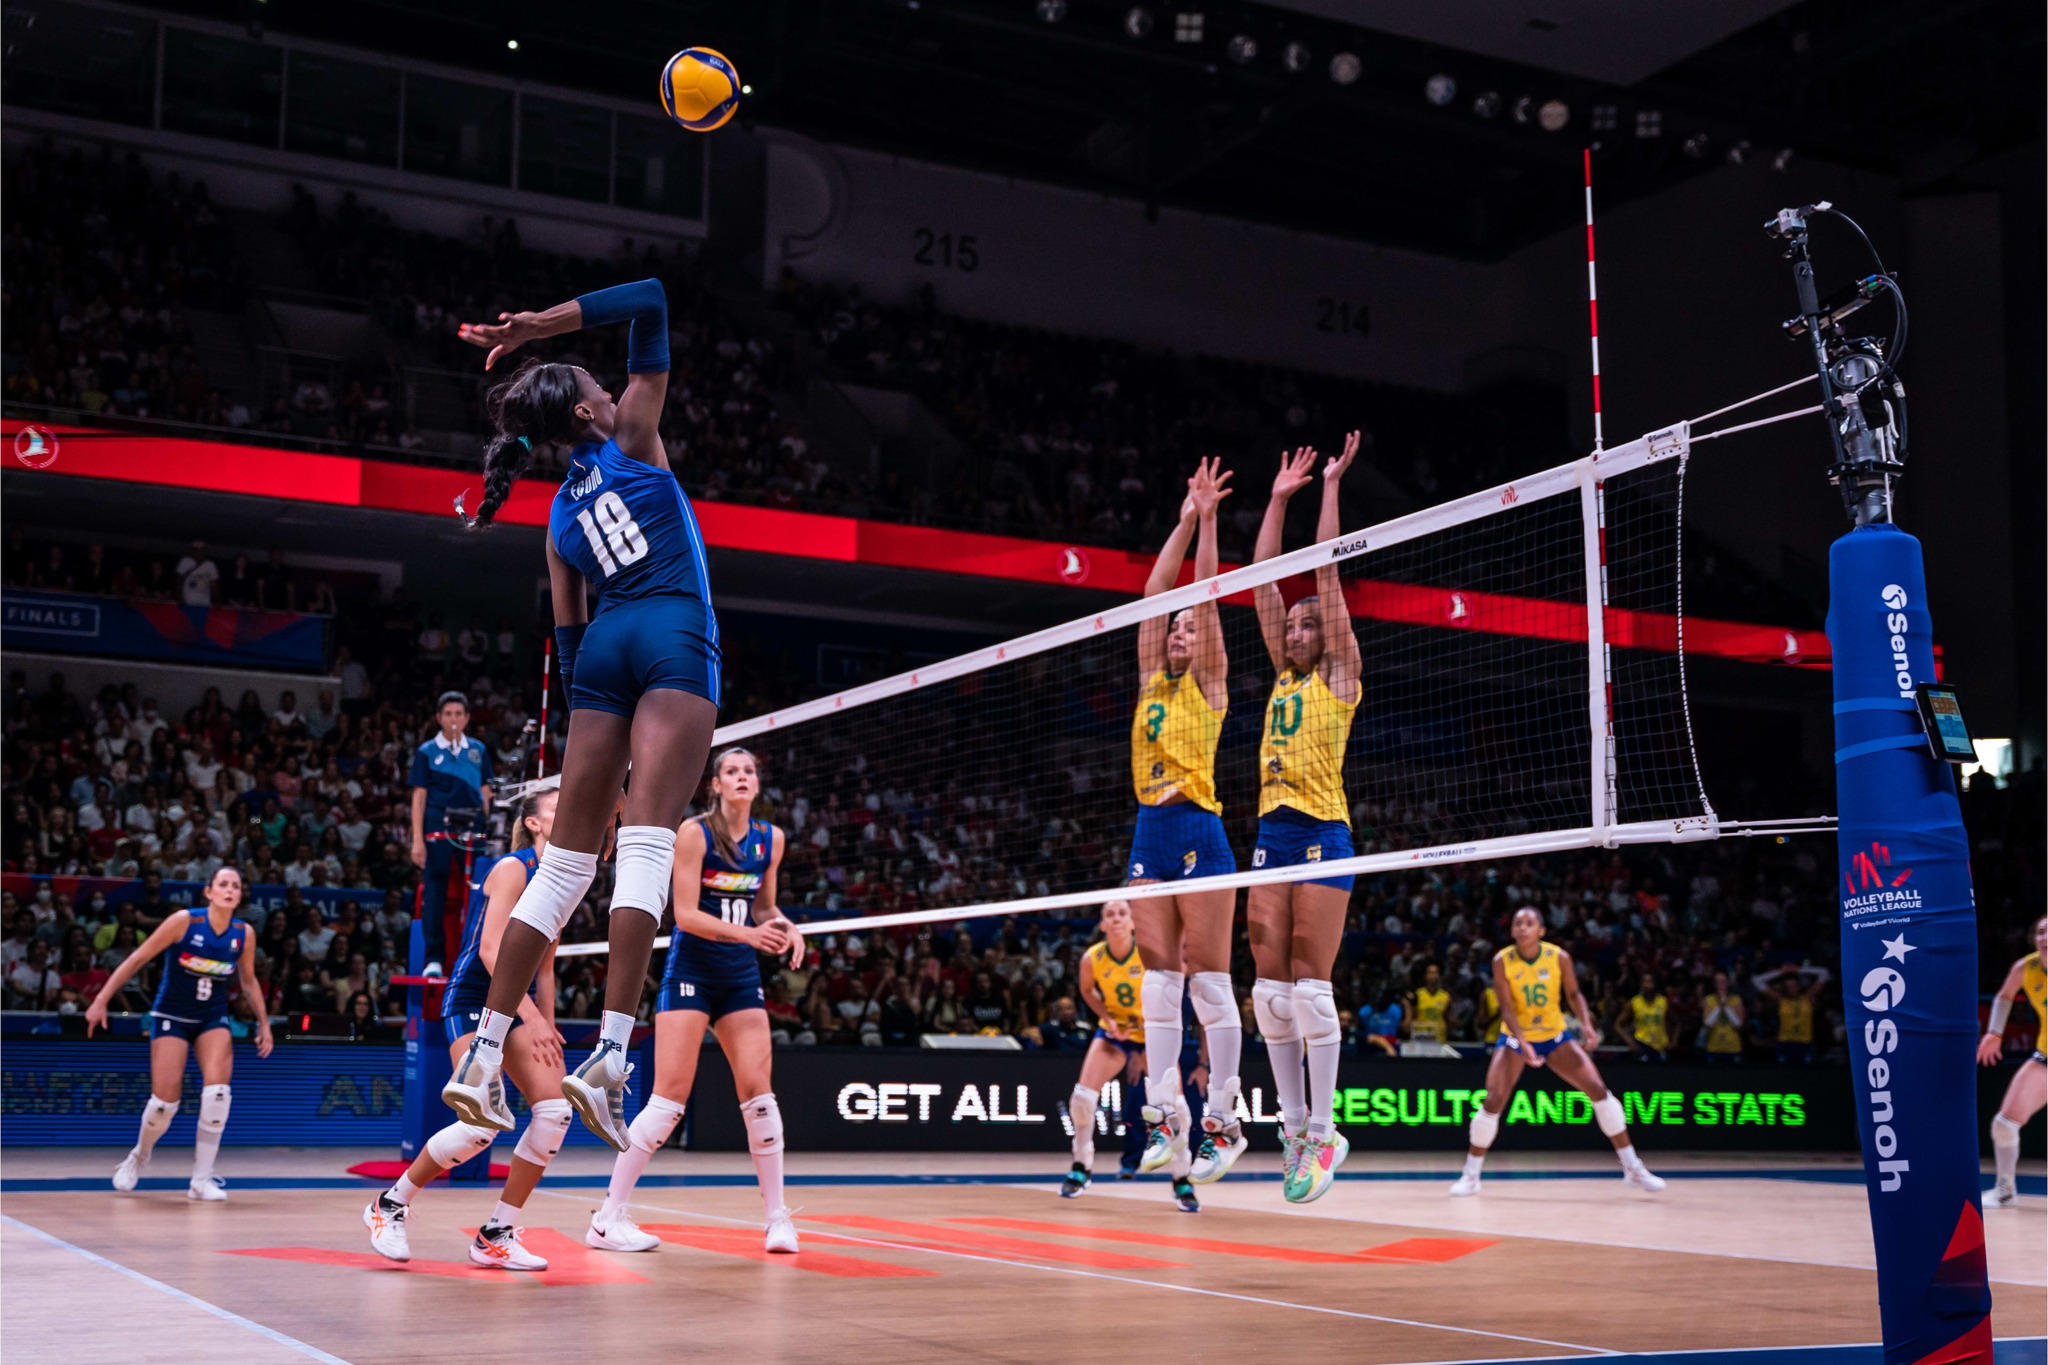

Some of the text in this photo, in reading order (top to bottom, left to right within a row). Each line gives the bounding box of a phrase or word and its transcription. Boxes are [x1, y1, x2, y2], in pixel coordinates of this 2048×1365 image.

[914, 227, 978, 272] 215
[1316, 298, 1370, 338] 214
[576, 491, 649, 578] 18
[7, 606, 81, 627] FINALS
[1146, 703, 1167, 742] 3
[1271, 692, 1303, 736] 10
[713, 872, 762, 890] DHL
[1131, 862, 1145, 878] 3
[720, 898, 748, 927] 10
[1843, 889, 1922, 910] VOLLEYBALL
[1843, 900, 1922, 919] NATIONS LEAGUE
[1860, 917, 1911, 928] Volleyball World
[1115, 983, 1136, 1008] 8
[1521, 983, 1548, 1008] 16
[837, 1082, 942, 1121] GET
[951, 1084, 1046, 1122] ALL
[1506, 1090, 1594, 1125] AND
[1622, 1091, 1685, 1125] IVE
[1693, 1092, 1807, 1126] STATS
[1864, 1018, 1910, 1193] Senoh
